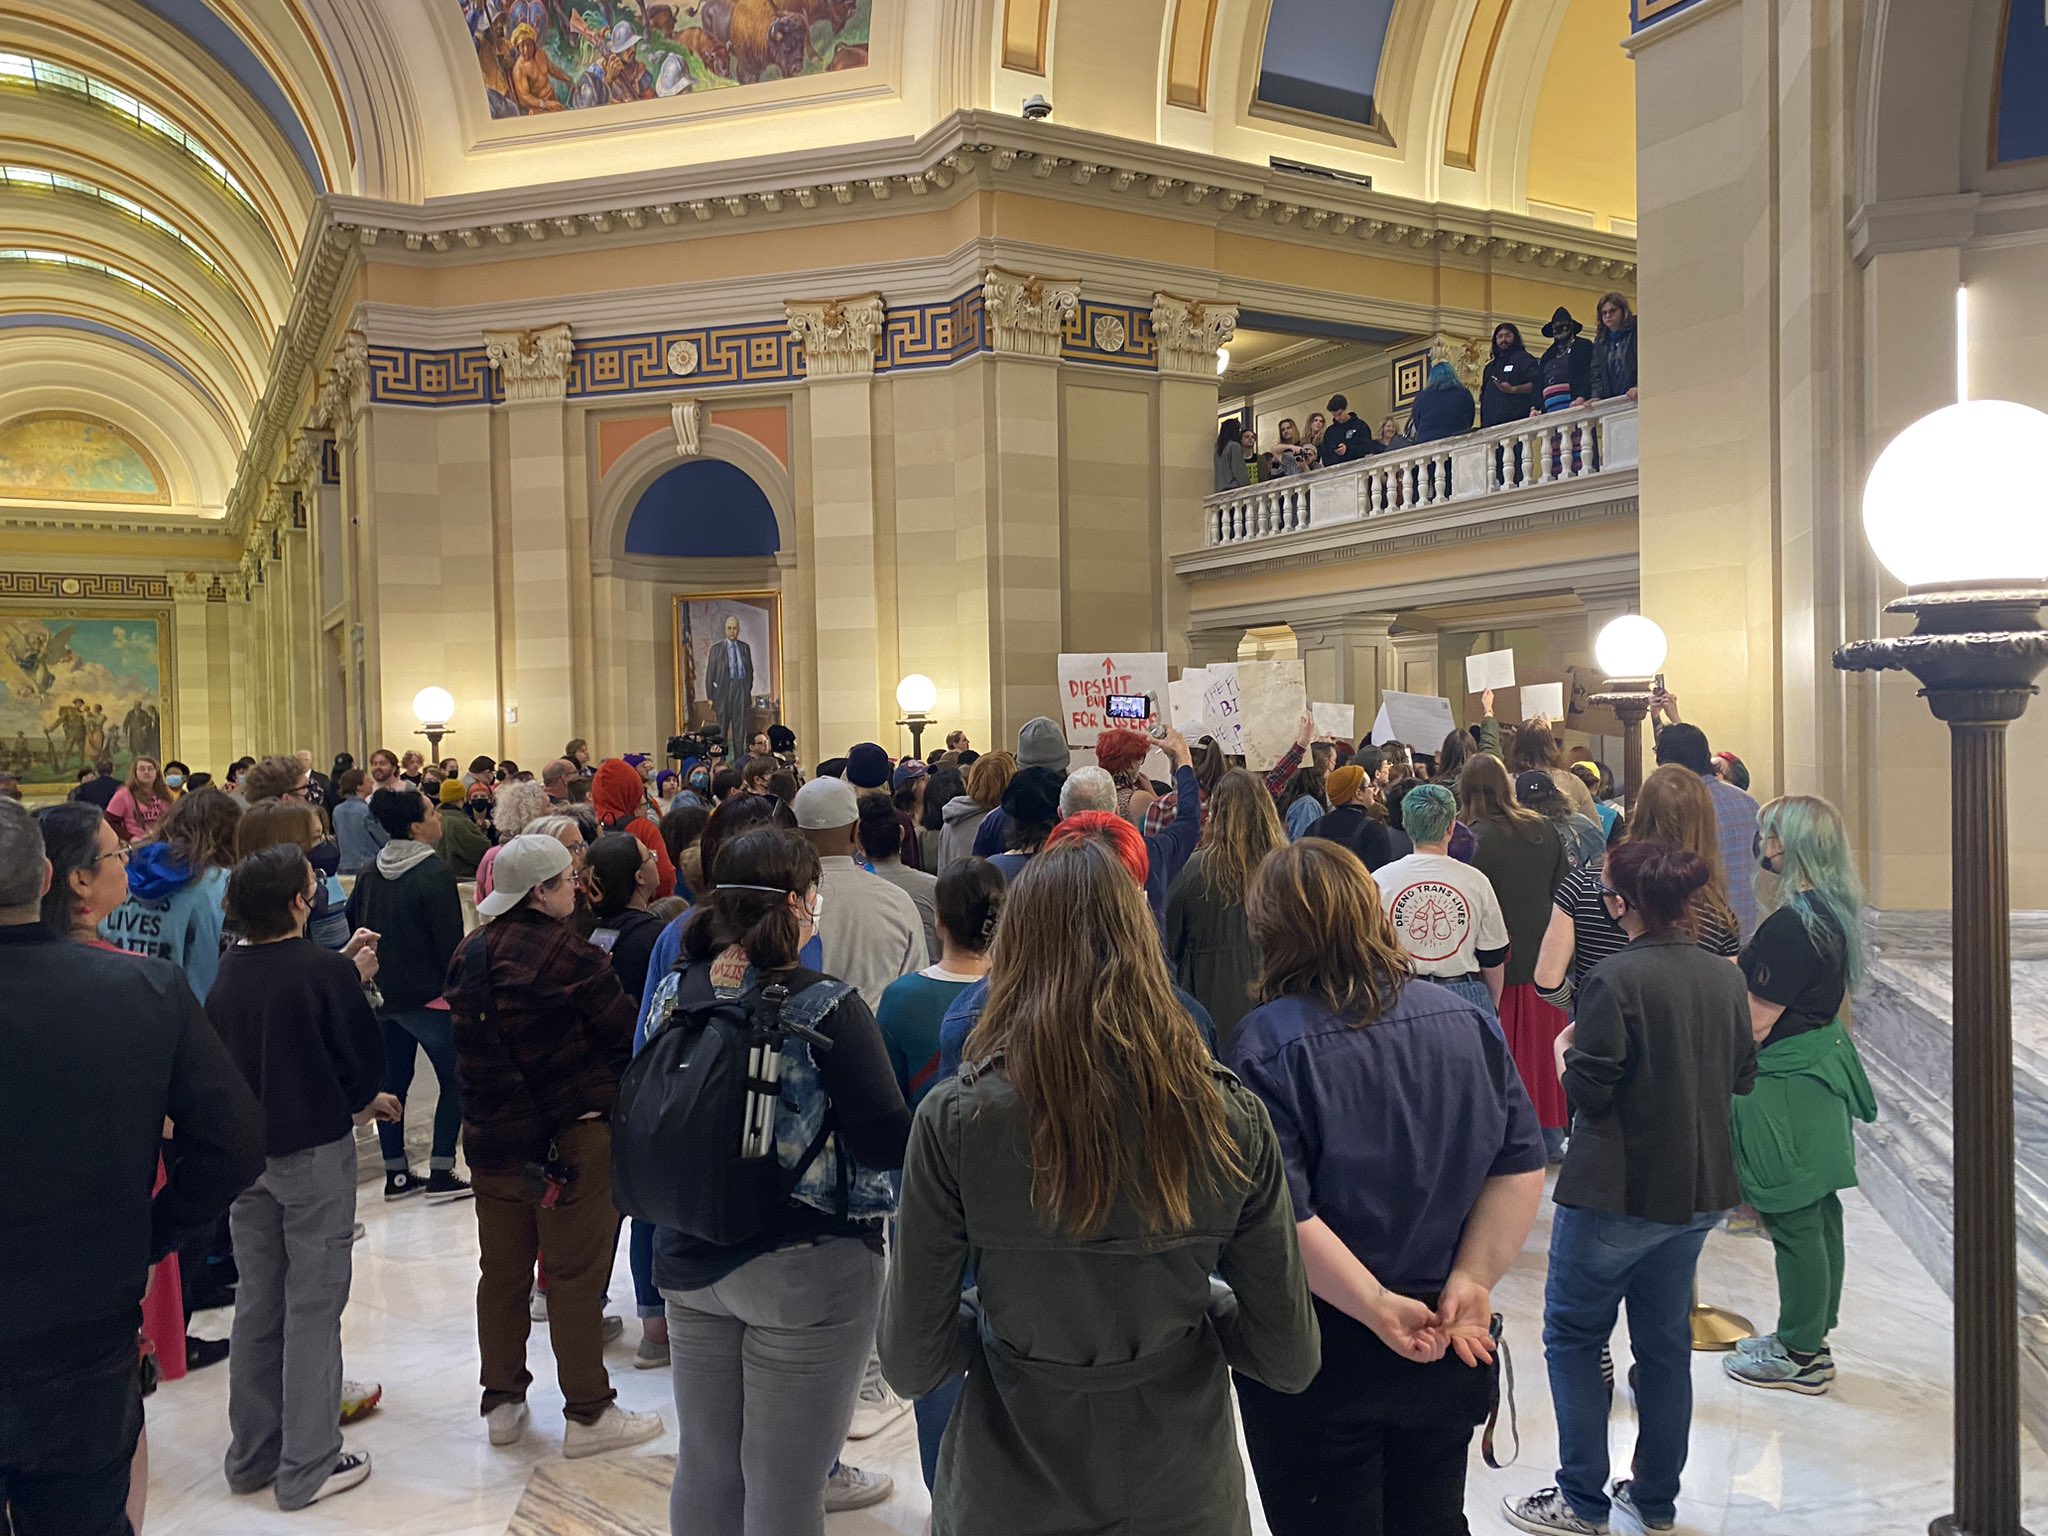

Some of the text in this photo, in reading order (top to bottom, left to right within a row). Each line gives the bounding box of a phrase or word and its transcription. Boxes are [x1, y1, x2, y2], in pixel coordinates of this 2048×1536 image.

[1068, 675, 1132, 698] DIPSHIT
[1072, 711, 1098, 730] FOR
[1394, 885, 1466, 927] DEFEND TRANS LIVES
[107, 911, 162, 937] LIVES
